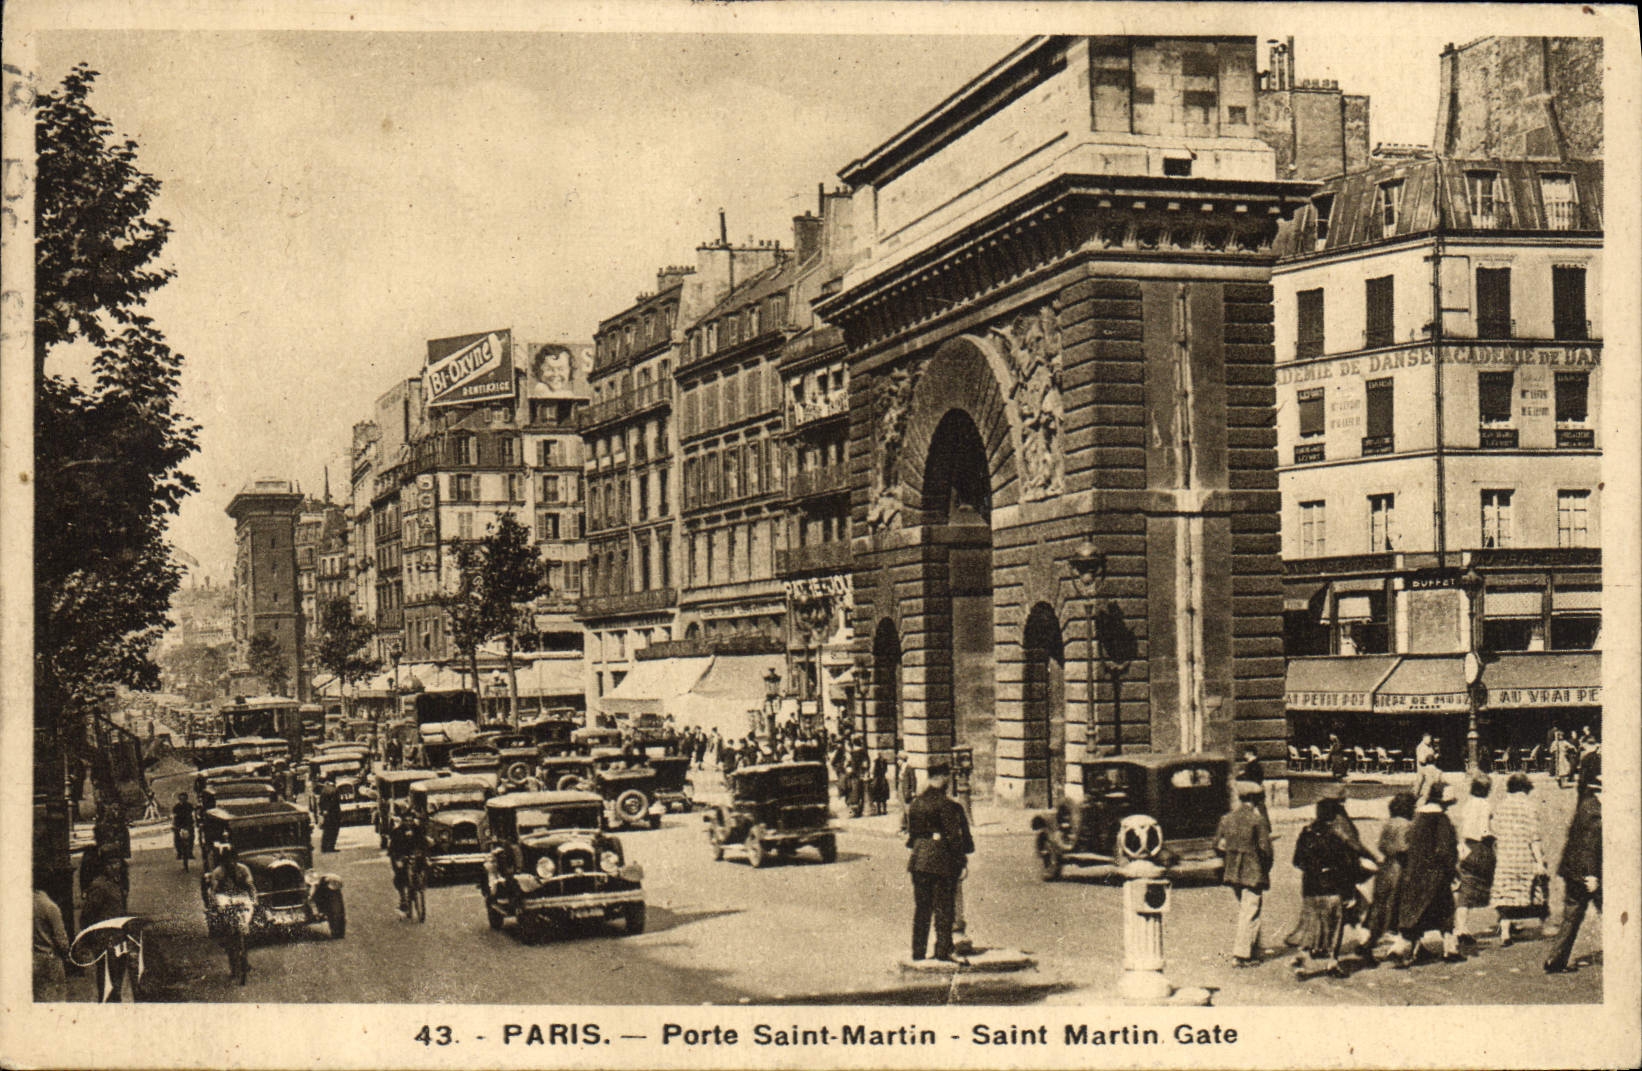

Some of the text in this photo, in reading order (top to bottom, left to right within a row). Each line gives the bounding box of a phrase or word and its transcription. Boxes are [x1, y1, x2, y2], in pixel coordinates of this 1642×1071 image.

[1538, 350, 1560, 365] DE
[1276, 348, 1433, 386] DEMIE DE DANSE
[1412, 578, 1456, 588] BUFFET
[1500, 690, 1522, 703] AU
[1526, 689, 1571, 703] VRAI
